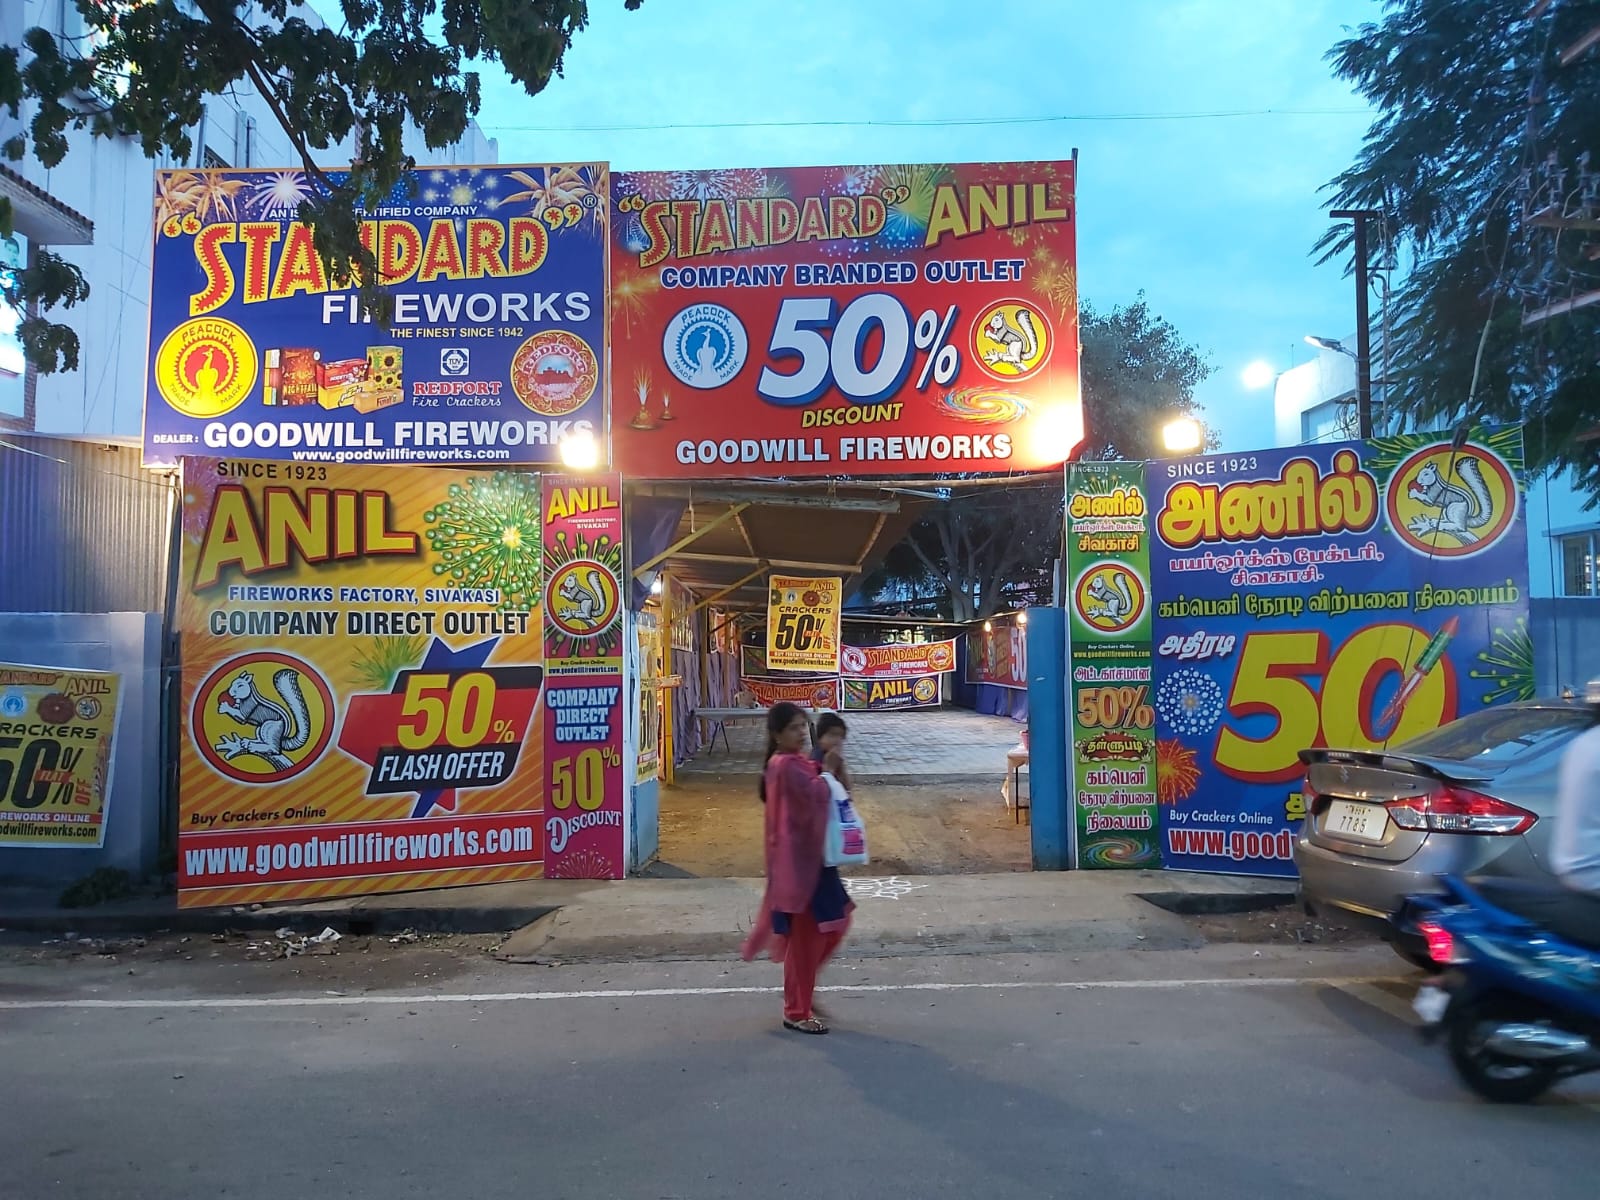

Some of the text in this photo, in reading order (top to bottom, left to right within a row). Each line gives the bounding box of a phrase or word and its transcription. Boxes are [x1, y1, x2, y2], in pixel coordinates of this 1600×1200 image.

[269, 208, 287, 218] AN
[414, 206, 478, 217] COMPANY
[925, 183, 1069, 249] ANIL
[661, 260, 1026, 289] COMPANY BRANDED OUTLET
[322, 291, 592, 324] FIEWORKS
[681, 306, 731, 324] PEACOCK
[181, 323, 237, 343] PEACOCK
[390, 327, 524, 338] THE FINEST SINCE 1942
[523, 343, 588, 374] REDFORT
[757, 292, 960, 403] 50%
[672, 360, 740, 381] TRADE MARK
[169, 383, 243, 407] TRADE MARK
[413, 381, 502, 396] REDFORT
[412, 396, 502, 408] Fire Crackers
[801, 403, 904, 428] DISCOUNT
[203, 421, 384, 448] GOODWILL
[292, 448, 510, 463] www.goodwillfireworks.com
[676, 434, 1013, 465] GOODWILL FIREWORKS
[217, 462, 327, 481] SINCE 1923
[1167, 457, 1259, 478] SINCE 1923
[546, 486, 619, 526] ANIL
[1069, 487, 1145, 519] அணில்
[1157, 449, 1379, 547] அணில்
[193, 485, 418, 592] ANIL
[1078, 535, 1139, 553] சிவகாசி
[228, 585, 500, 605] FIREWORKS FACTORY, SIVAKASI
[1158, 578, 1520, 619] கம்பெனி நேரடி விற்பனை நிலையம்
[779, 606, 832, 614] CRACKERS
[209, 610, 530, 637] COMPANY DIRECT OUTLET
[775, 613, 826, 651] 50%
[1158, 630, 1236, 660] அதிரடி
[64, 676, 111, 698] ANIL
[547, 687, 619, 708] COMPANY
[869, 680, 912, 703] ANIL
[398, 672, 515, 751] 50%
[1077, 685, 1155, 730] 50%
[1213, 622, 1451, 781] 50
[556, 708, 609, 724] DIRECT
[0, 722, 99, 740] RACKERS
[556, 726, 609, 741] OUTLET
[1087, 738, 1144, 753] தள்ளுபடி
[377, 751, 506, 783] FLASH OFFER
[551, 744, 621, 811] 50%
[1086, 764, 1147, 786] கம்பெனி
[1079, 791, 1107, 809] நேரடி
[53, 812, 91, 823] ONLINE
[190, 805, 327, 826] Buy Crackers Online
[1169, 809, 1274, 825] Buy Crackers Online
[185, 824, 533, 877] www.goodwillfireworks.com
[1168, 828, 1297, 861] www.good
